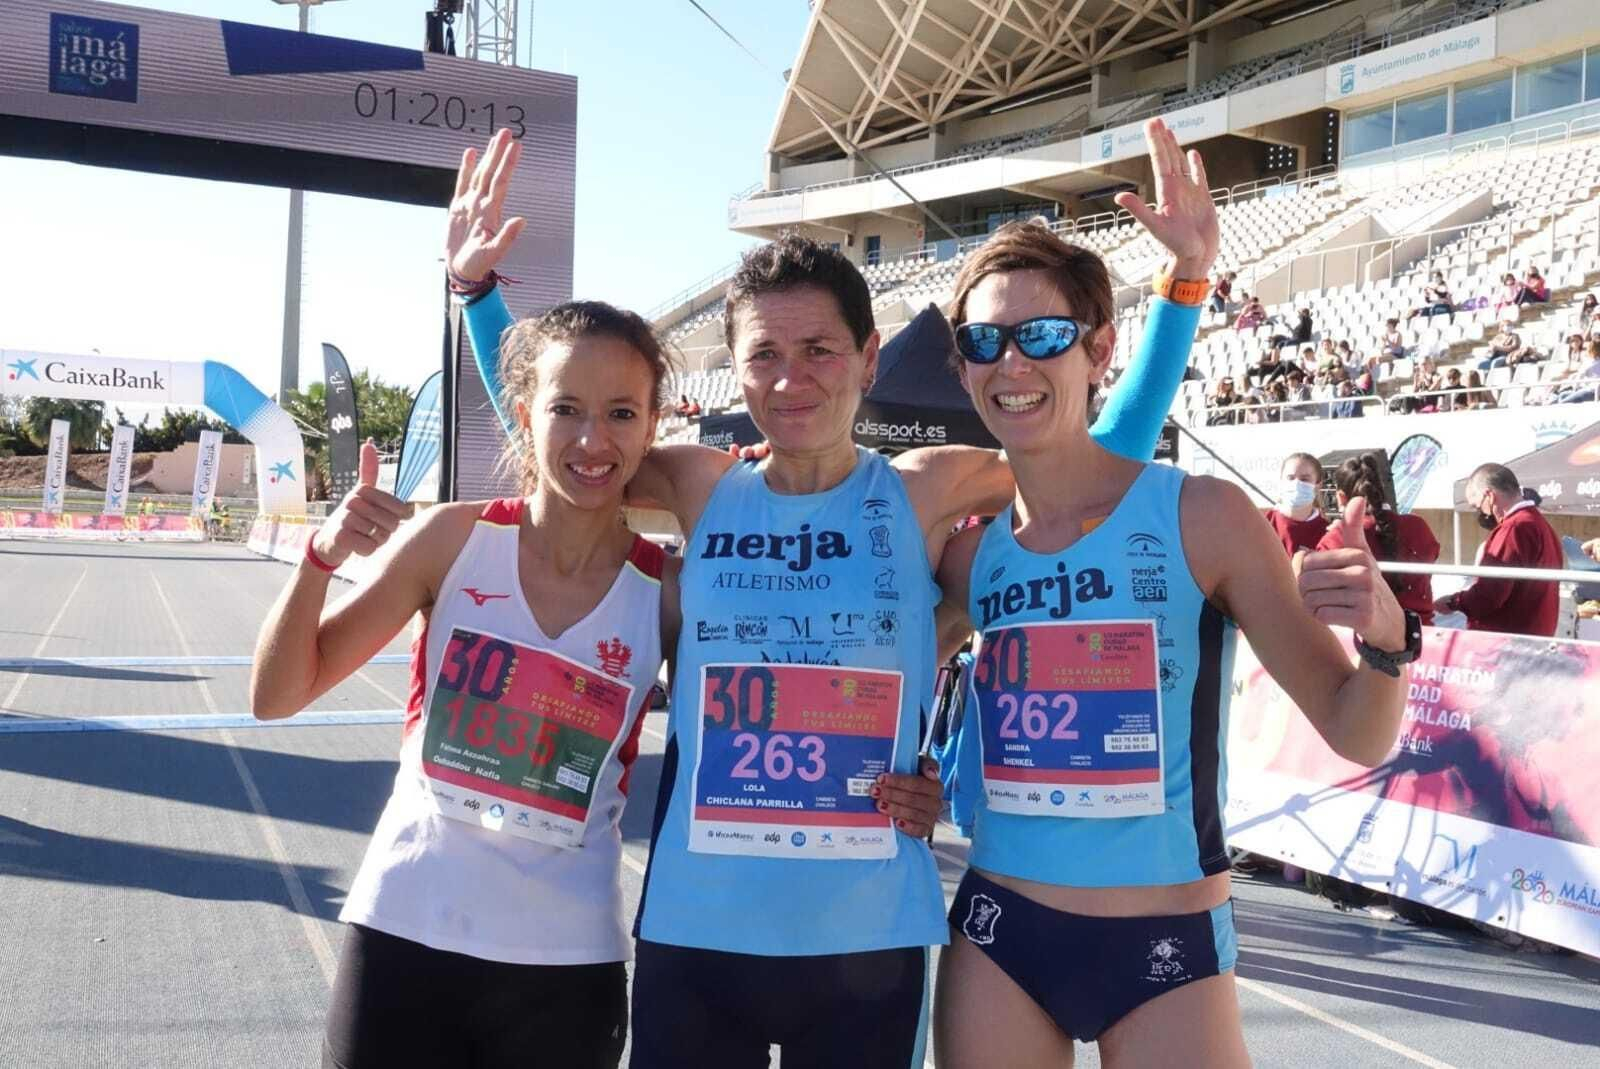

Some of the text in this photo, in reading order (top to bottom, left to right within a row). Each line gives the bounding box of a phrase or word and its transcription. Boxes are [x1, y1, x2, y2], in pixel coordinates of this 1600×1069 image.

[71, 31, 128, 62] má
[1361, 35, 1481, 77] Ayuntamiento de Málaga
[60, 46, 127, 86] laga
[355, 83, 526, 139] 01:20:13
[45, 361, 165, 390] CaixaBank
[854, 418, 947, 441] alssport.es
[199, 443, 216, 494] CaixaBank
[1539, 480, 1562, 499] edp
[701, 523, 851, 572] nerja
[711, 572, 831, 591] ATLETISMO
[1131, 568, 1158, 580] nerja
[1131, 578, 1166, 587] Centro
[977, 561, 1113, 628] nerja
[1134, 587, 1167, 599] aen
[437, 632, 516, 702] 30
[1412, 662, 1496, 689] MARATÓN
[704, 666, 775, 730] 30
[1408, 683, 1442, 703] DAD
[996, 693, 1080, 740] 262
[444, 695, 560, 768] 1835
[730, 732, 827, 782] 263
[1004, 743, 1031, 752] SANDRA
[743, 784, 766, 793] LOLA
[1026, 790, 1042, 804] edp
[463, 799, 480, 811] edp
[706, 796, 804, 809] CHICLANA PARRILLA
[764, 831, 781, 844] edp
